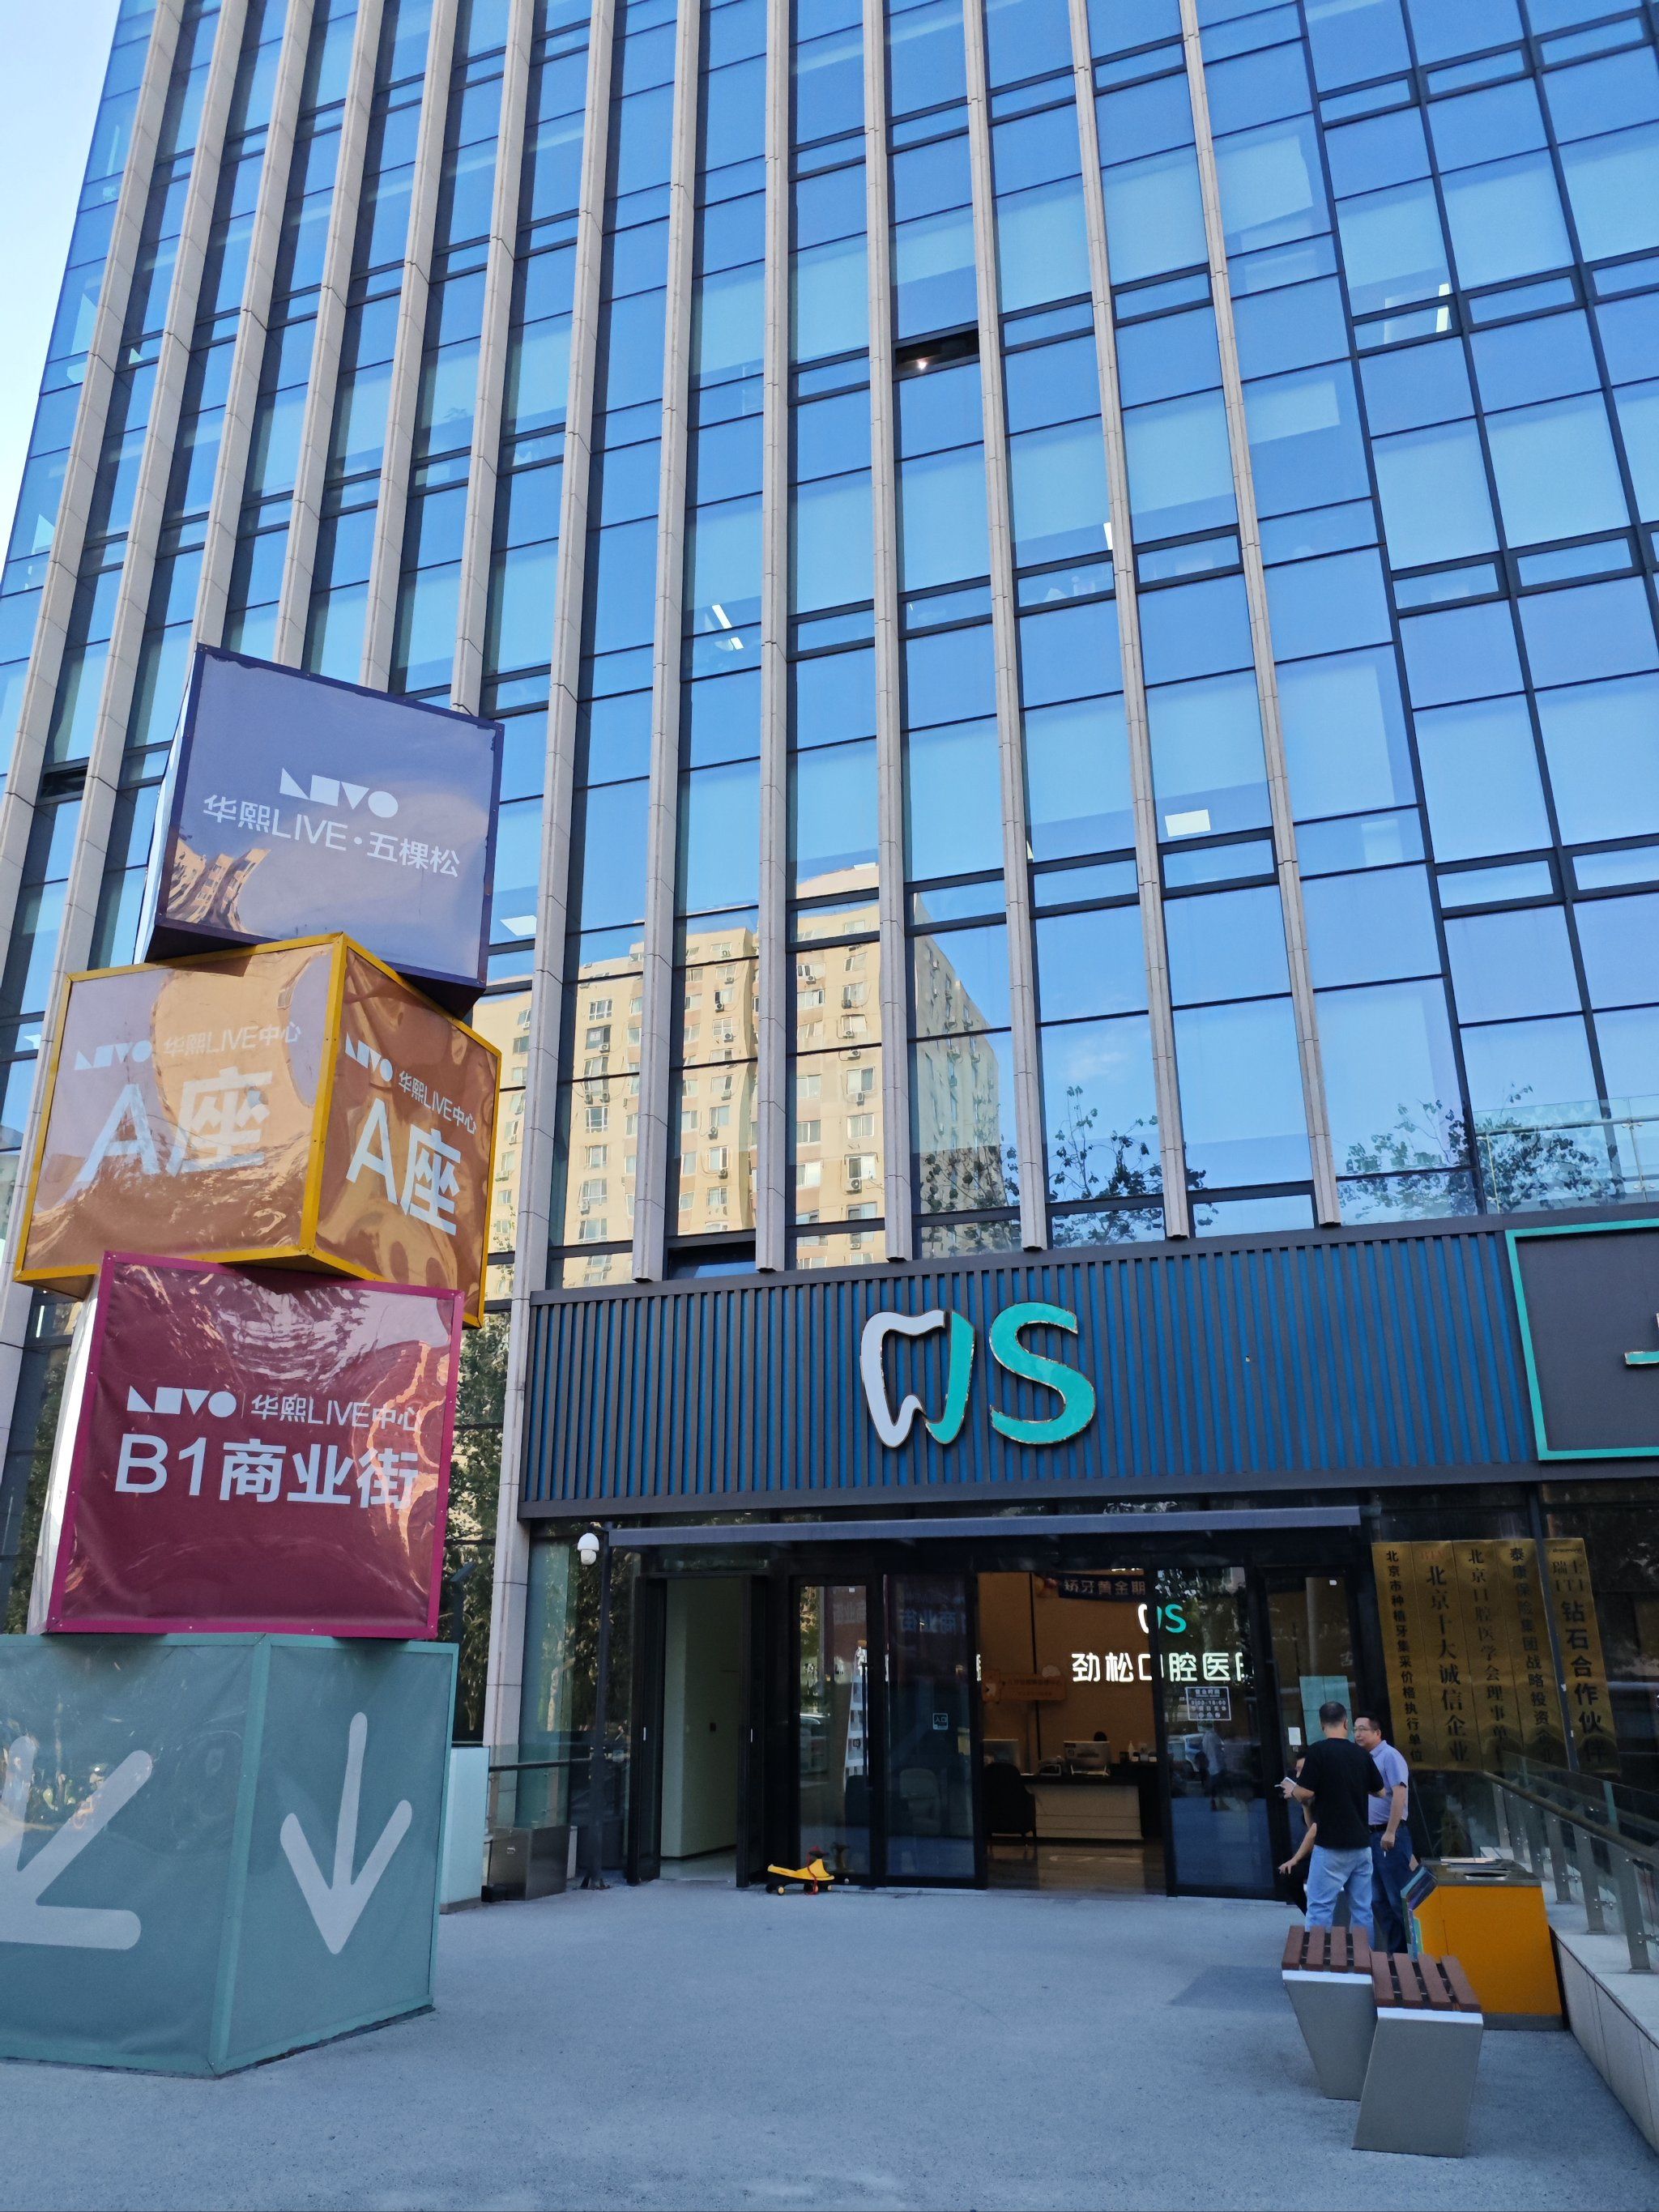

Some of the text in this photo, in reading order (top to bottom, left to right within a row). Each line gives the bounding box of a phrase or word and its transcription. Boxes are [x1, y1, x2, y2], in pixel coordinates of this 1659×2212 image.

[163, 1021, 302, 1058] 华熙LIVE中心
[47, 1067, 274, 1207] A座
[398, 1070, 477, 1136] 华熙LIVE中心
[346, 1099, 462, 1236] A座
[251, 1394, 419, 1431] 华熙LIVE中心
[114, 1433, 419, 1510] B1商业街
[1427, 1565, 1469, 1762] 北京十大诚信企业
[1560, 1600, 1608, 1763] 钻石合作伙伴
